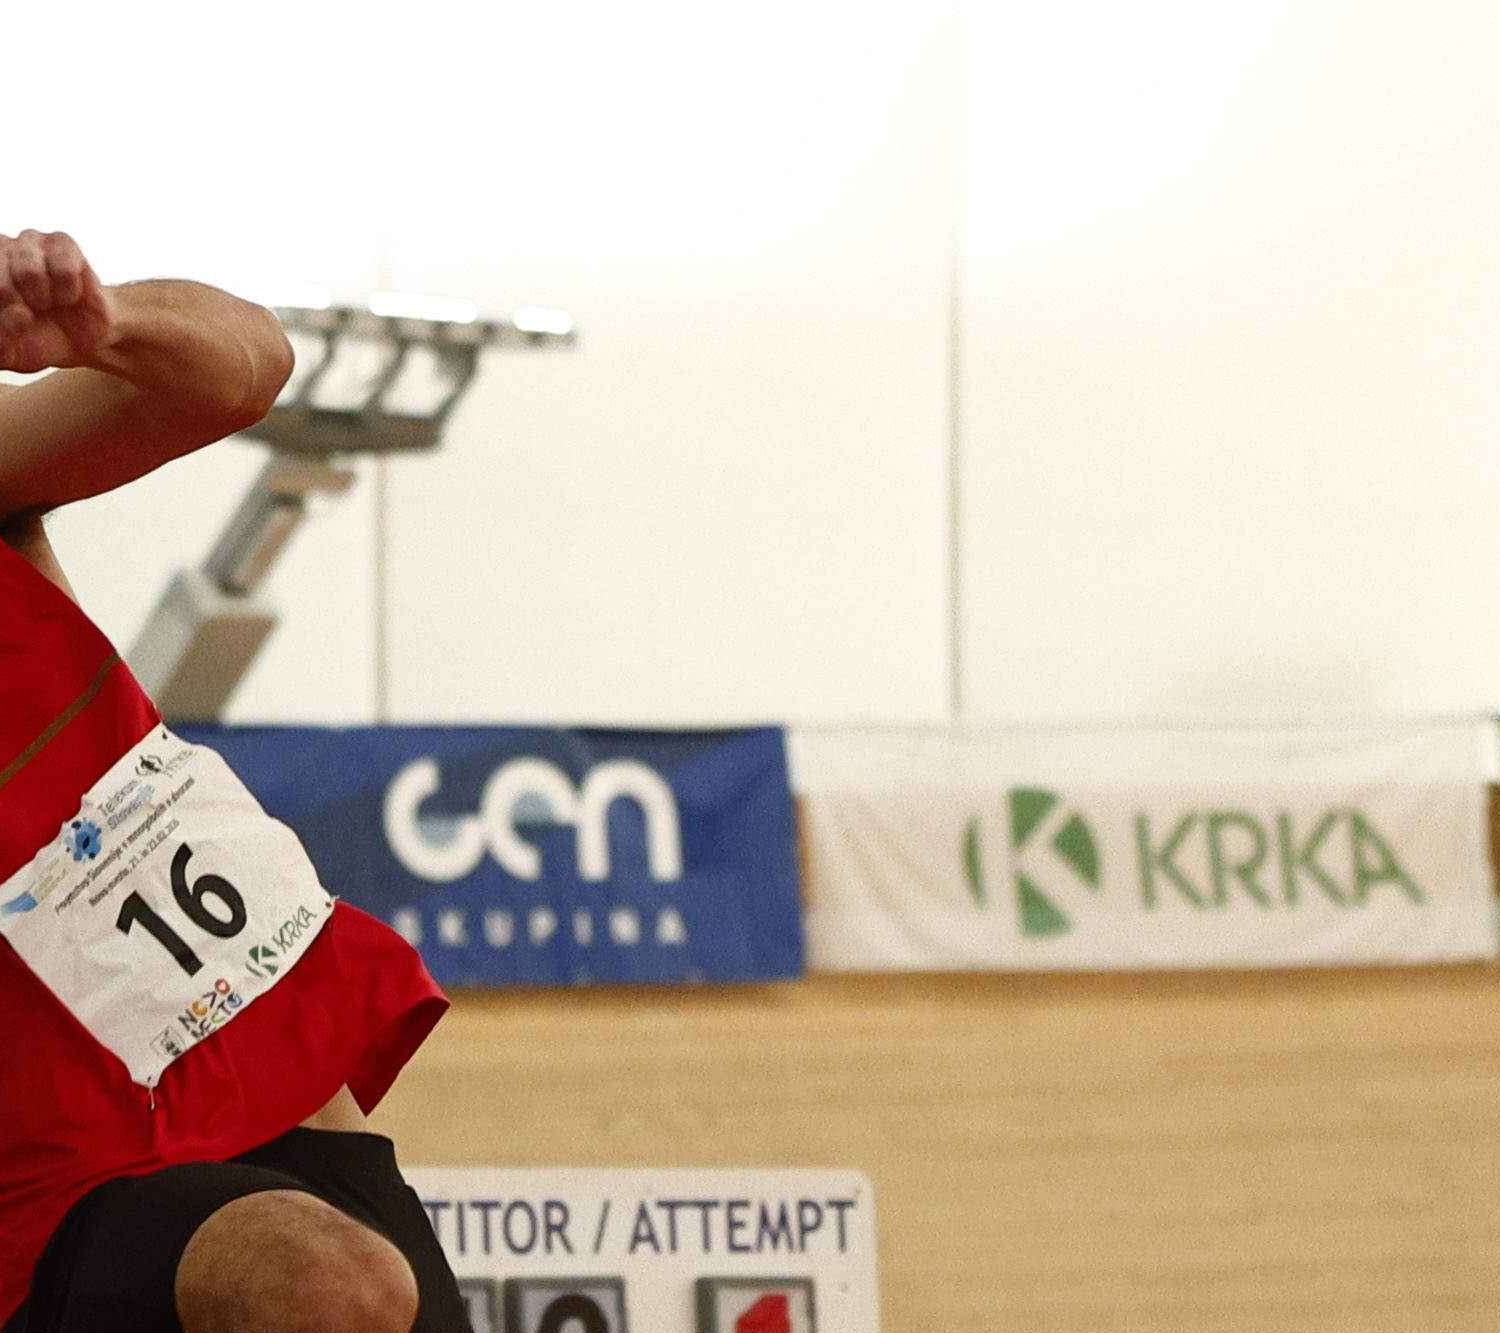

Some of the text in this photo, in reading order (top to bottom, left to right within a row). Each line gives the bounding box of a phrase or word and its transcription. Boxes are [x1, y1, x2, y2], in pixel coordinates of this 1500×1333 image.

[1133, 808, 1429, 908] KRKA
[115, 842, 248, 978] 16
[273, 905, 318, 955] KRKA
[424, 1199, 575, 1255] TITOR
[628, 1199, 857, 1254] ATTEMPT
